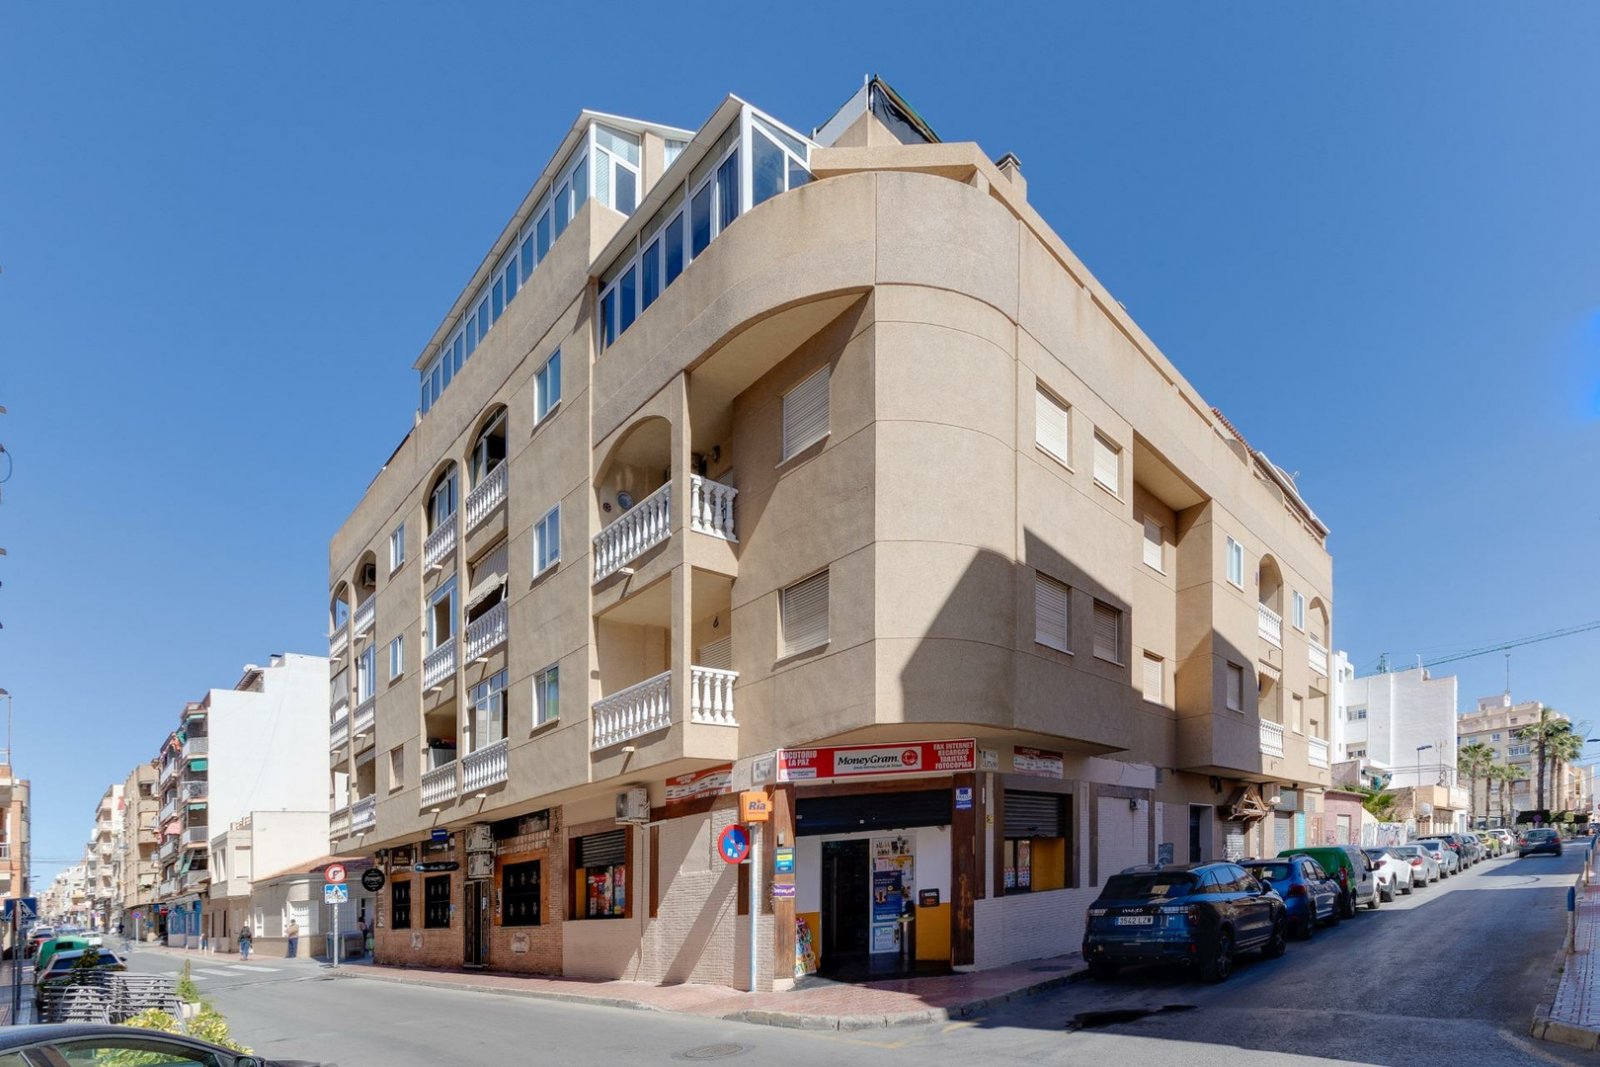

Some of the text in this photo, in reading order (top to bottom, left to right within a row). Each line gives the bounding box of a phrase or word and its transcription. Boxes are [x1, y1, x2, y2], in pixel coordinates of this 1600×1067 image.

[946, 741, 973, 749] INTERNET
[780, 751, 817, 760] LOCUTORIO
[938, 748, 969, 756] RECARGAS
[797, 758, 809, 766] PAZ
[837, 754, 898, 766] MoneyGram
[935, 761, 972, 769] FOTOCOPIAS
[748, 799, 766, 811] Ria
